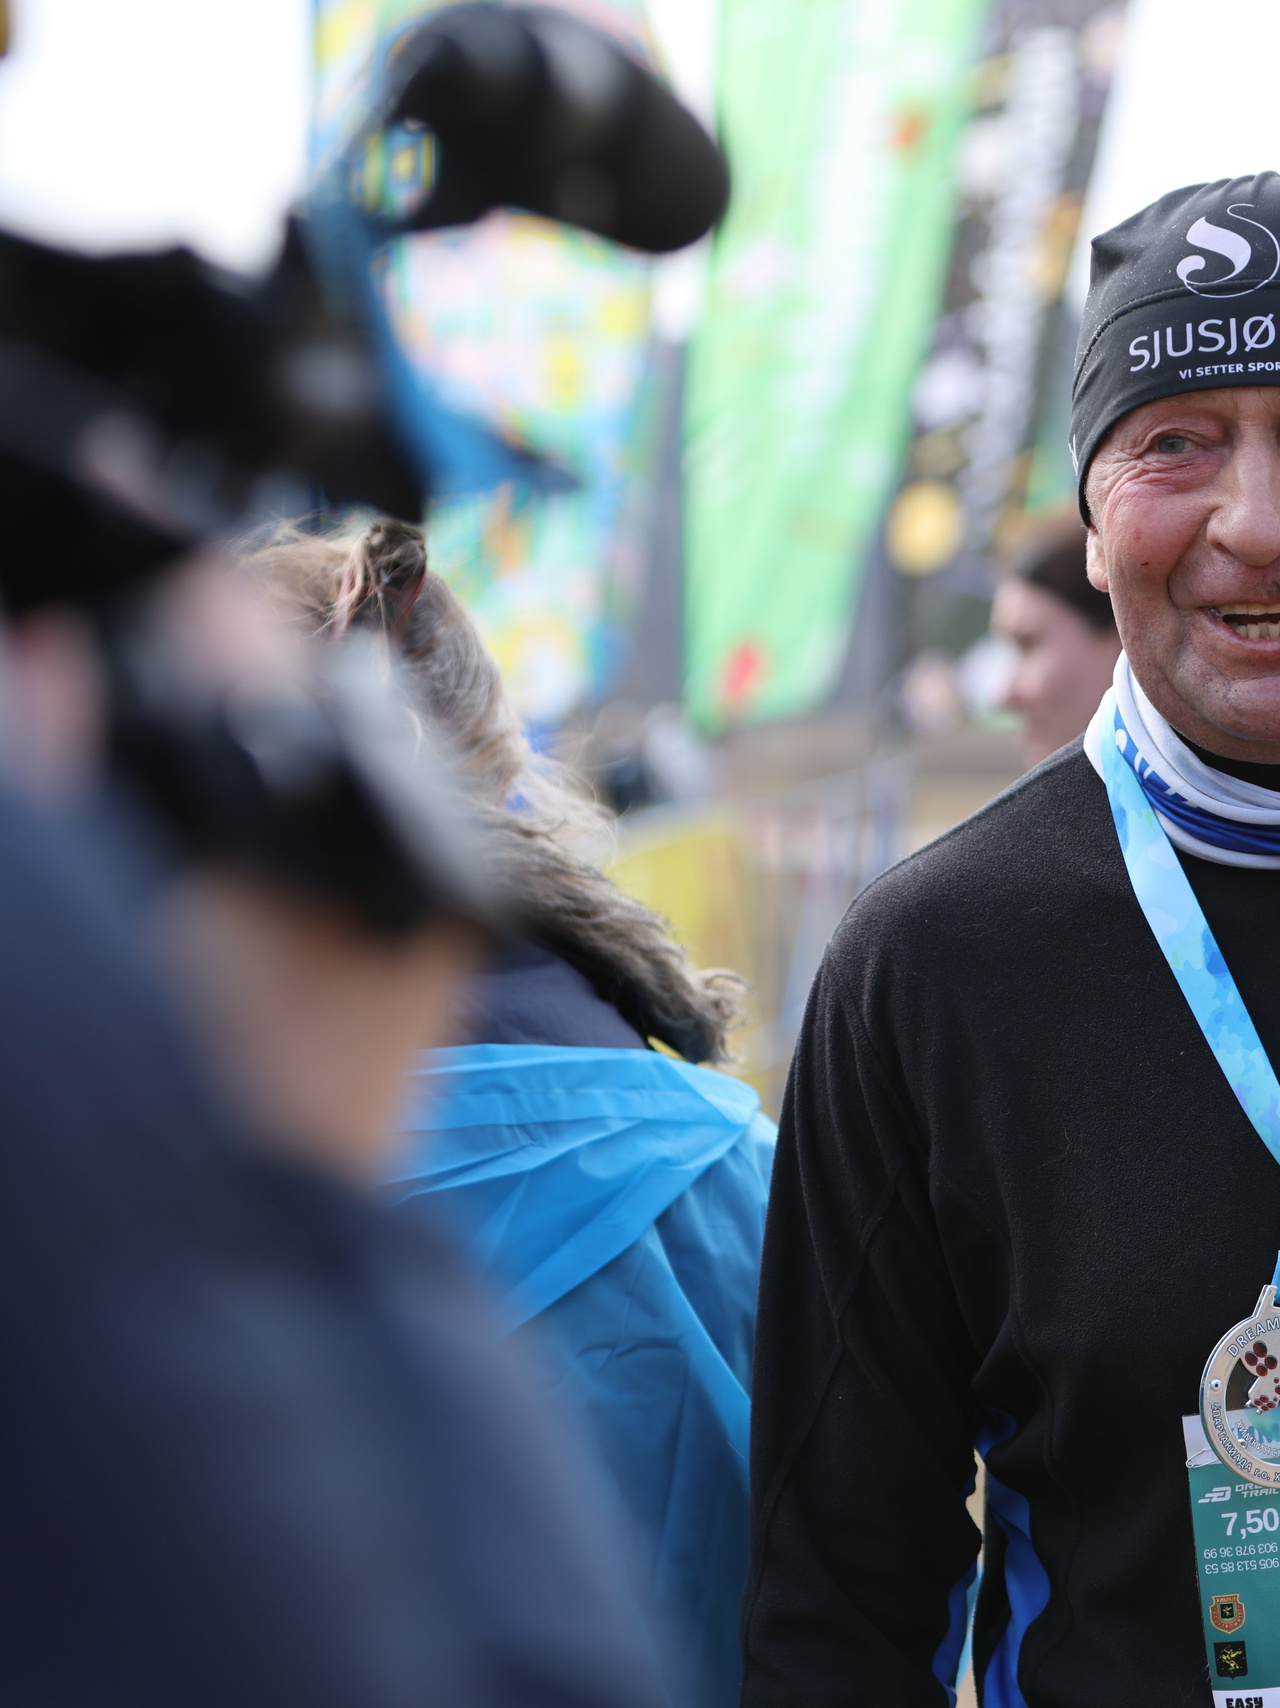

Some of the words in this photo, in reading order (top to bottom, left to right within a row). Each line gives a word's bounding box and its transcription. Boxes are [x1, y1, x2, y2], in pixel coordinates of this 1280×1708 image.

[1179, 370, 1192, 380] VI
[1196, 364, 1244, 377] SETTER
[1227, 1317, 1280, 1358] DREAM
[1235, 1484, 1263, 1492] DRE
[1241, 1488, 1279, 1498] TRAIL
[1221, 1507, 1280, 1539] 7,50
[1219, 1547, 1233, 1557] 36
[1235, 1544, 1256, 1556] 978
[1258, 1542, 1278, 1554] 903
[1203, 1549, 1218, 1559] 99
[1204, 1563, 1219, 1574] 53
[1220, 1562, 1235, 1572] 85
[1237, 1559, 1257, 1571] 513
[1259, 1558, 1280, 1569] 905
[1225, 1696, 1264, 1708] EASY
